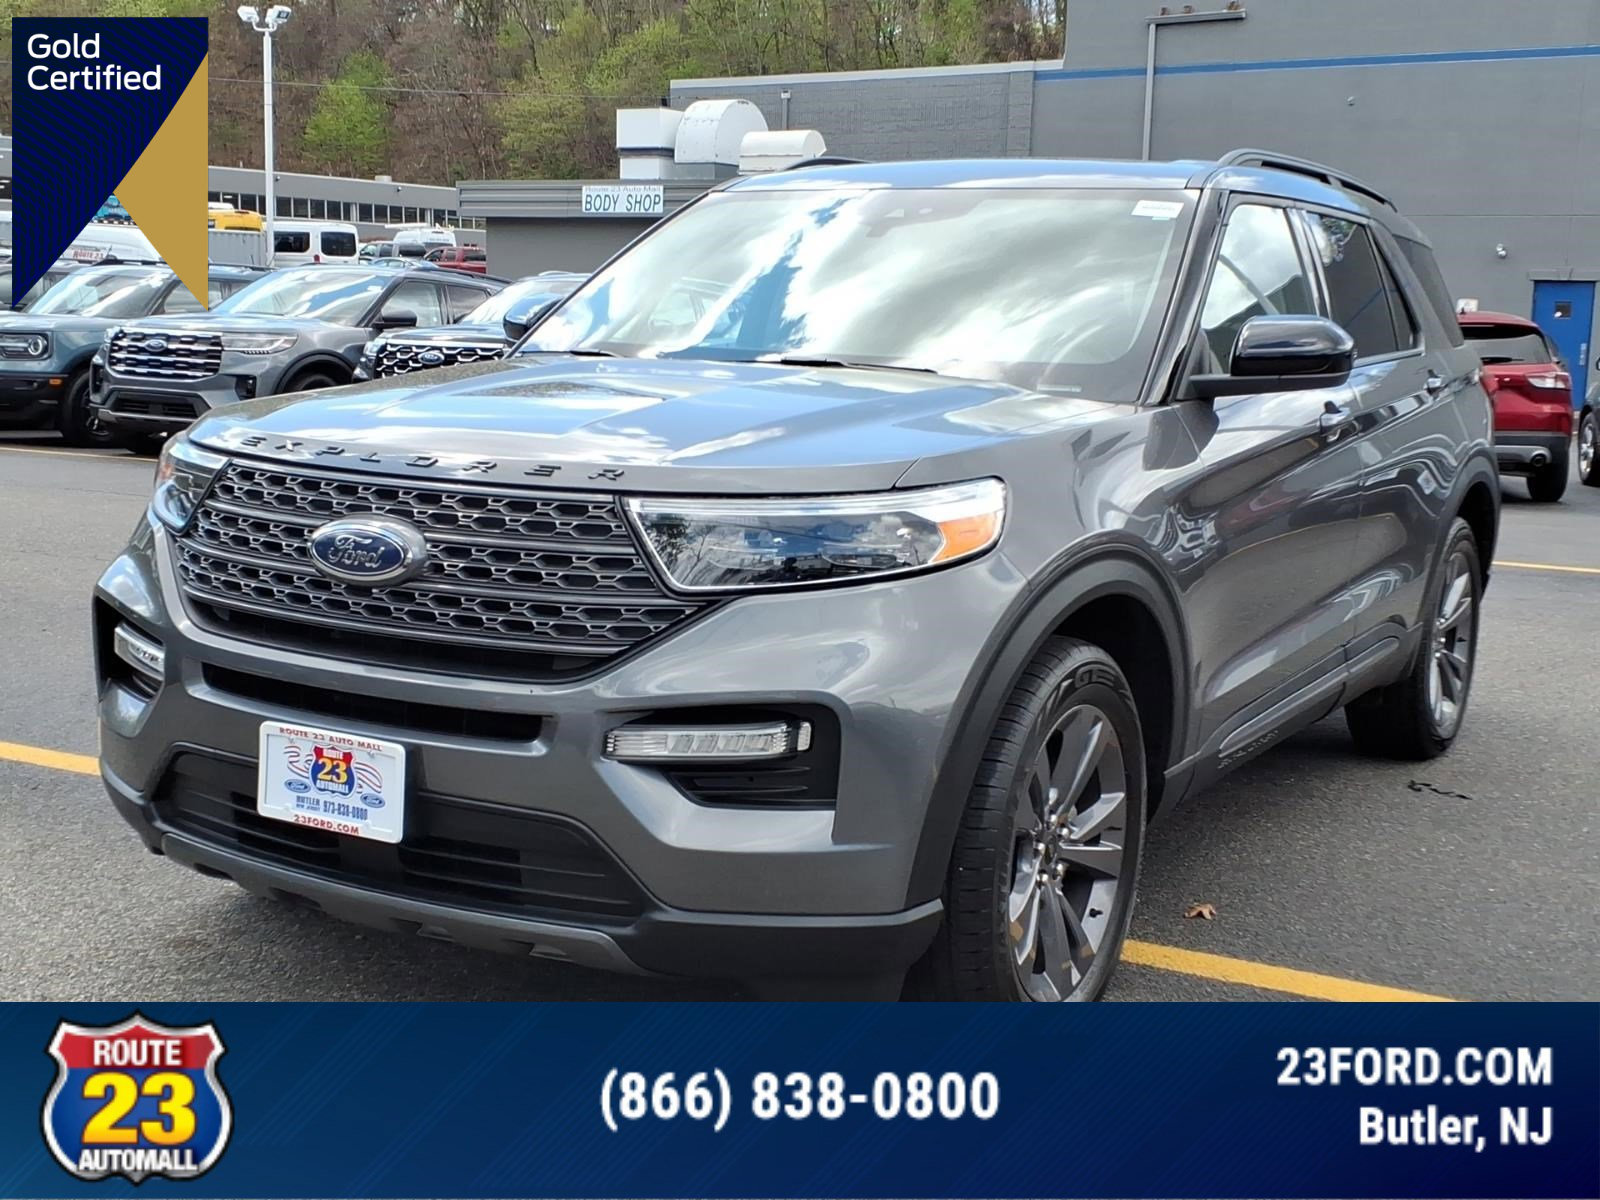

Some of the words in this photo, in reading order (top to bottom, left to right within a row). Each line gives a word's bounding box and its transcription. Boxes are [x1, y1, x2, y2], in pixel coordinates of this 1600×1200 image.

[585, 194, 619, 211] BODY
[626, 194, 660, 211] SHOP
[240, 435, 625, 481] EXPLORER
[328, 534, 386, 568] Ford
[279, 727, 309, 738] ROUTE
[329, 736, 354, 746] AUTO
[357, 741, 383, 752] MALL
[317, 757, 348, 784] 23
[294, 814, 360, 835] 23FORD.COM
